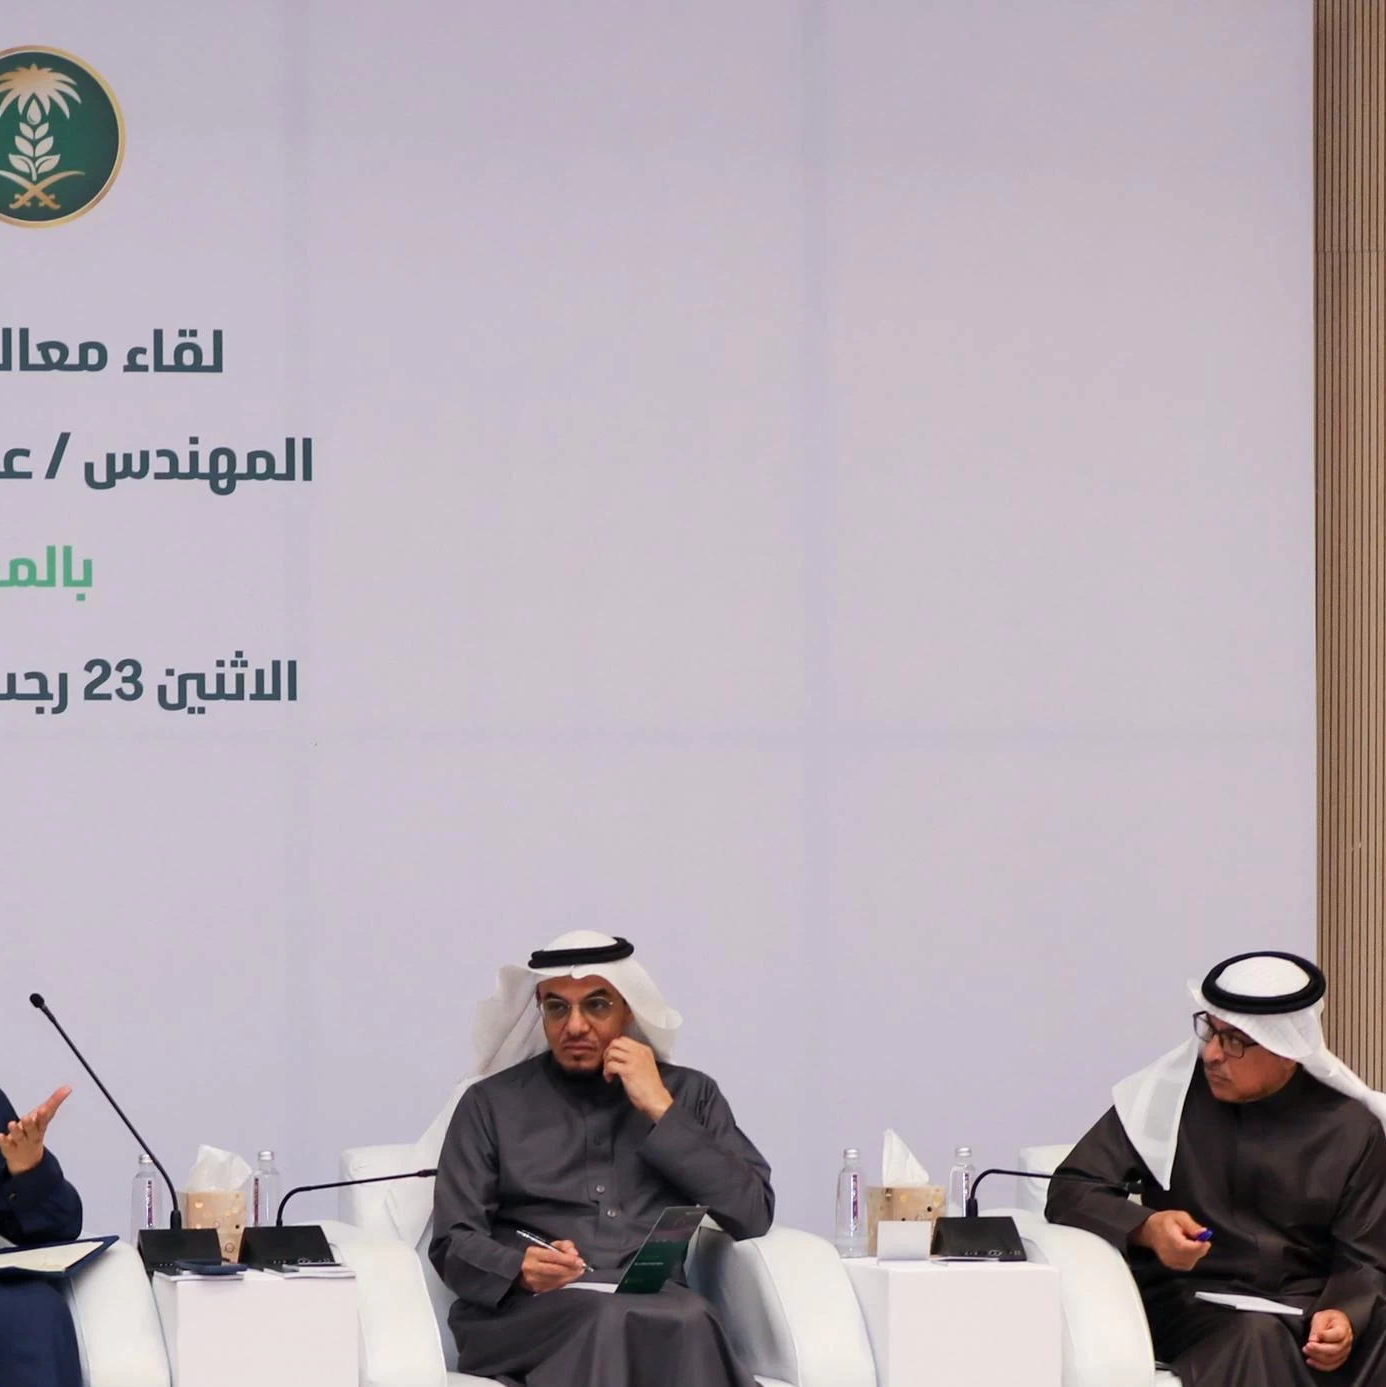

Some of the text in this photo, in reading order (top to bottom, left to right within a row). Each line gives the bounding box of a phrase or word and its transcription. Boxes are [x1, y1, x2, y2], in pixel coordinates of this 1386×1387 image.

[123, 327, 224, 374] لقاء
[84, 436, 313, 496] المهندس
[83, 658, 145, 702] 23
[158, 651, 298, 715] الاثنين
